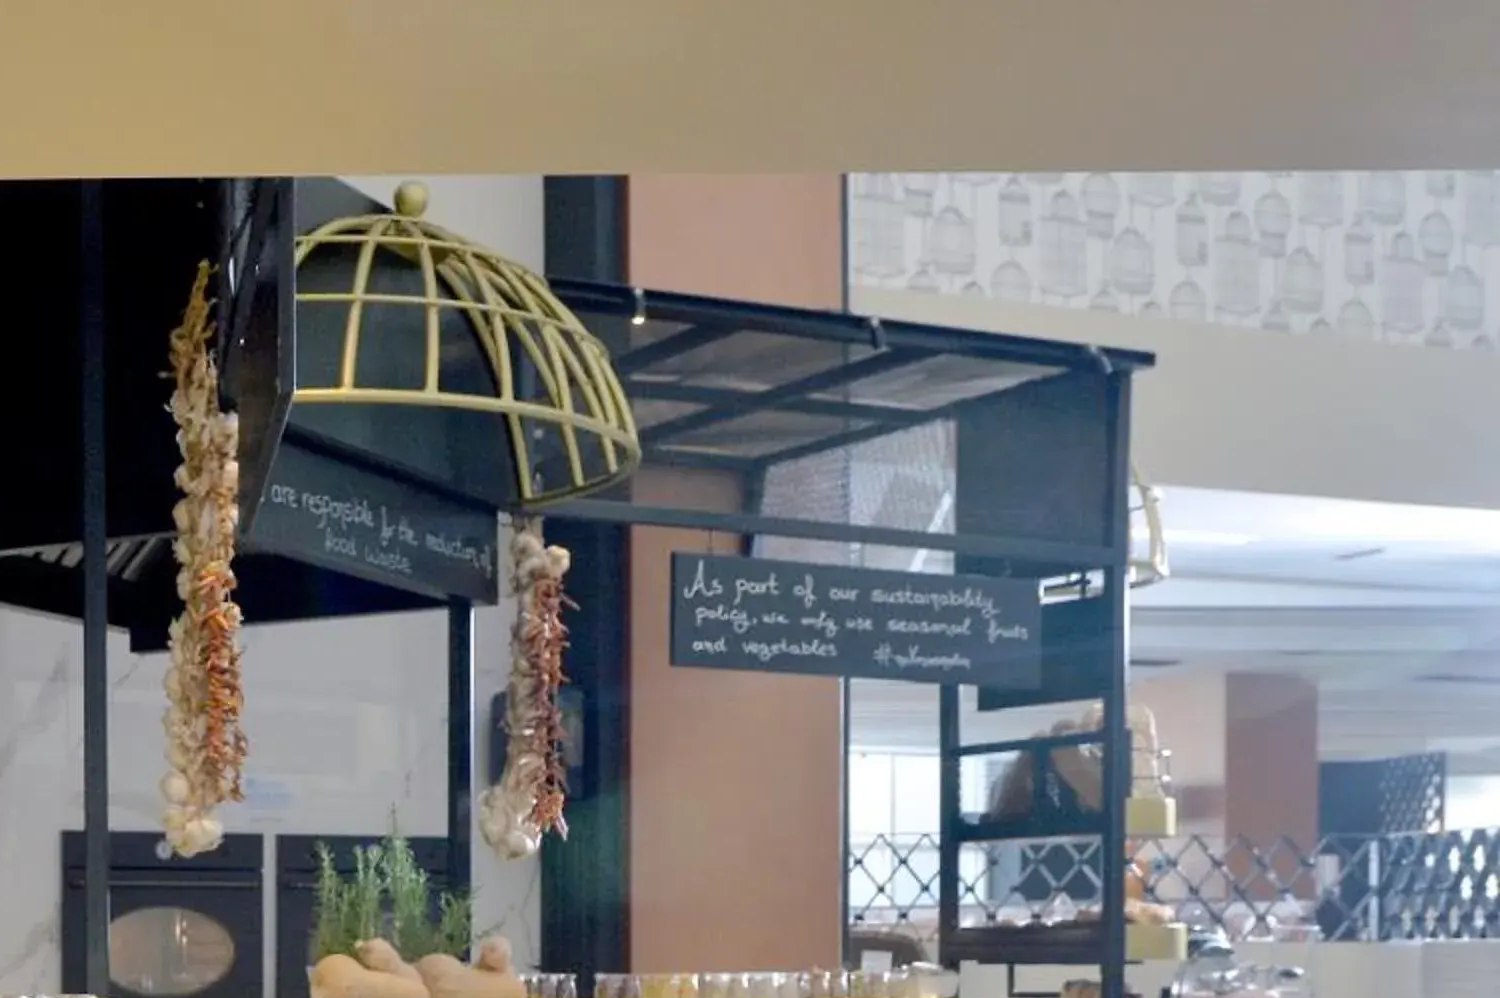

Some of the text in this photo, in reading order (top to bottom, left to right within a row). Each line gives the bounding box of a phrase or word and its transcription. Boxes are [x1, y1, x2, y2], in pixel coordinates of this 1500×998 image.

[683, 558, 1001, 620] As part of our sustainability
[844, 617, 873, 632] use
[886, 616, 972, 637] seasonal
[691, 636, 839, 663] and vegetables
